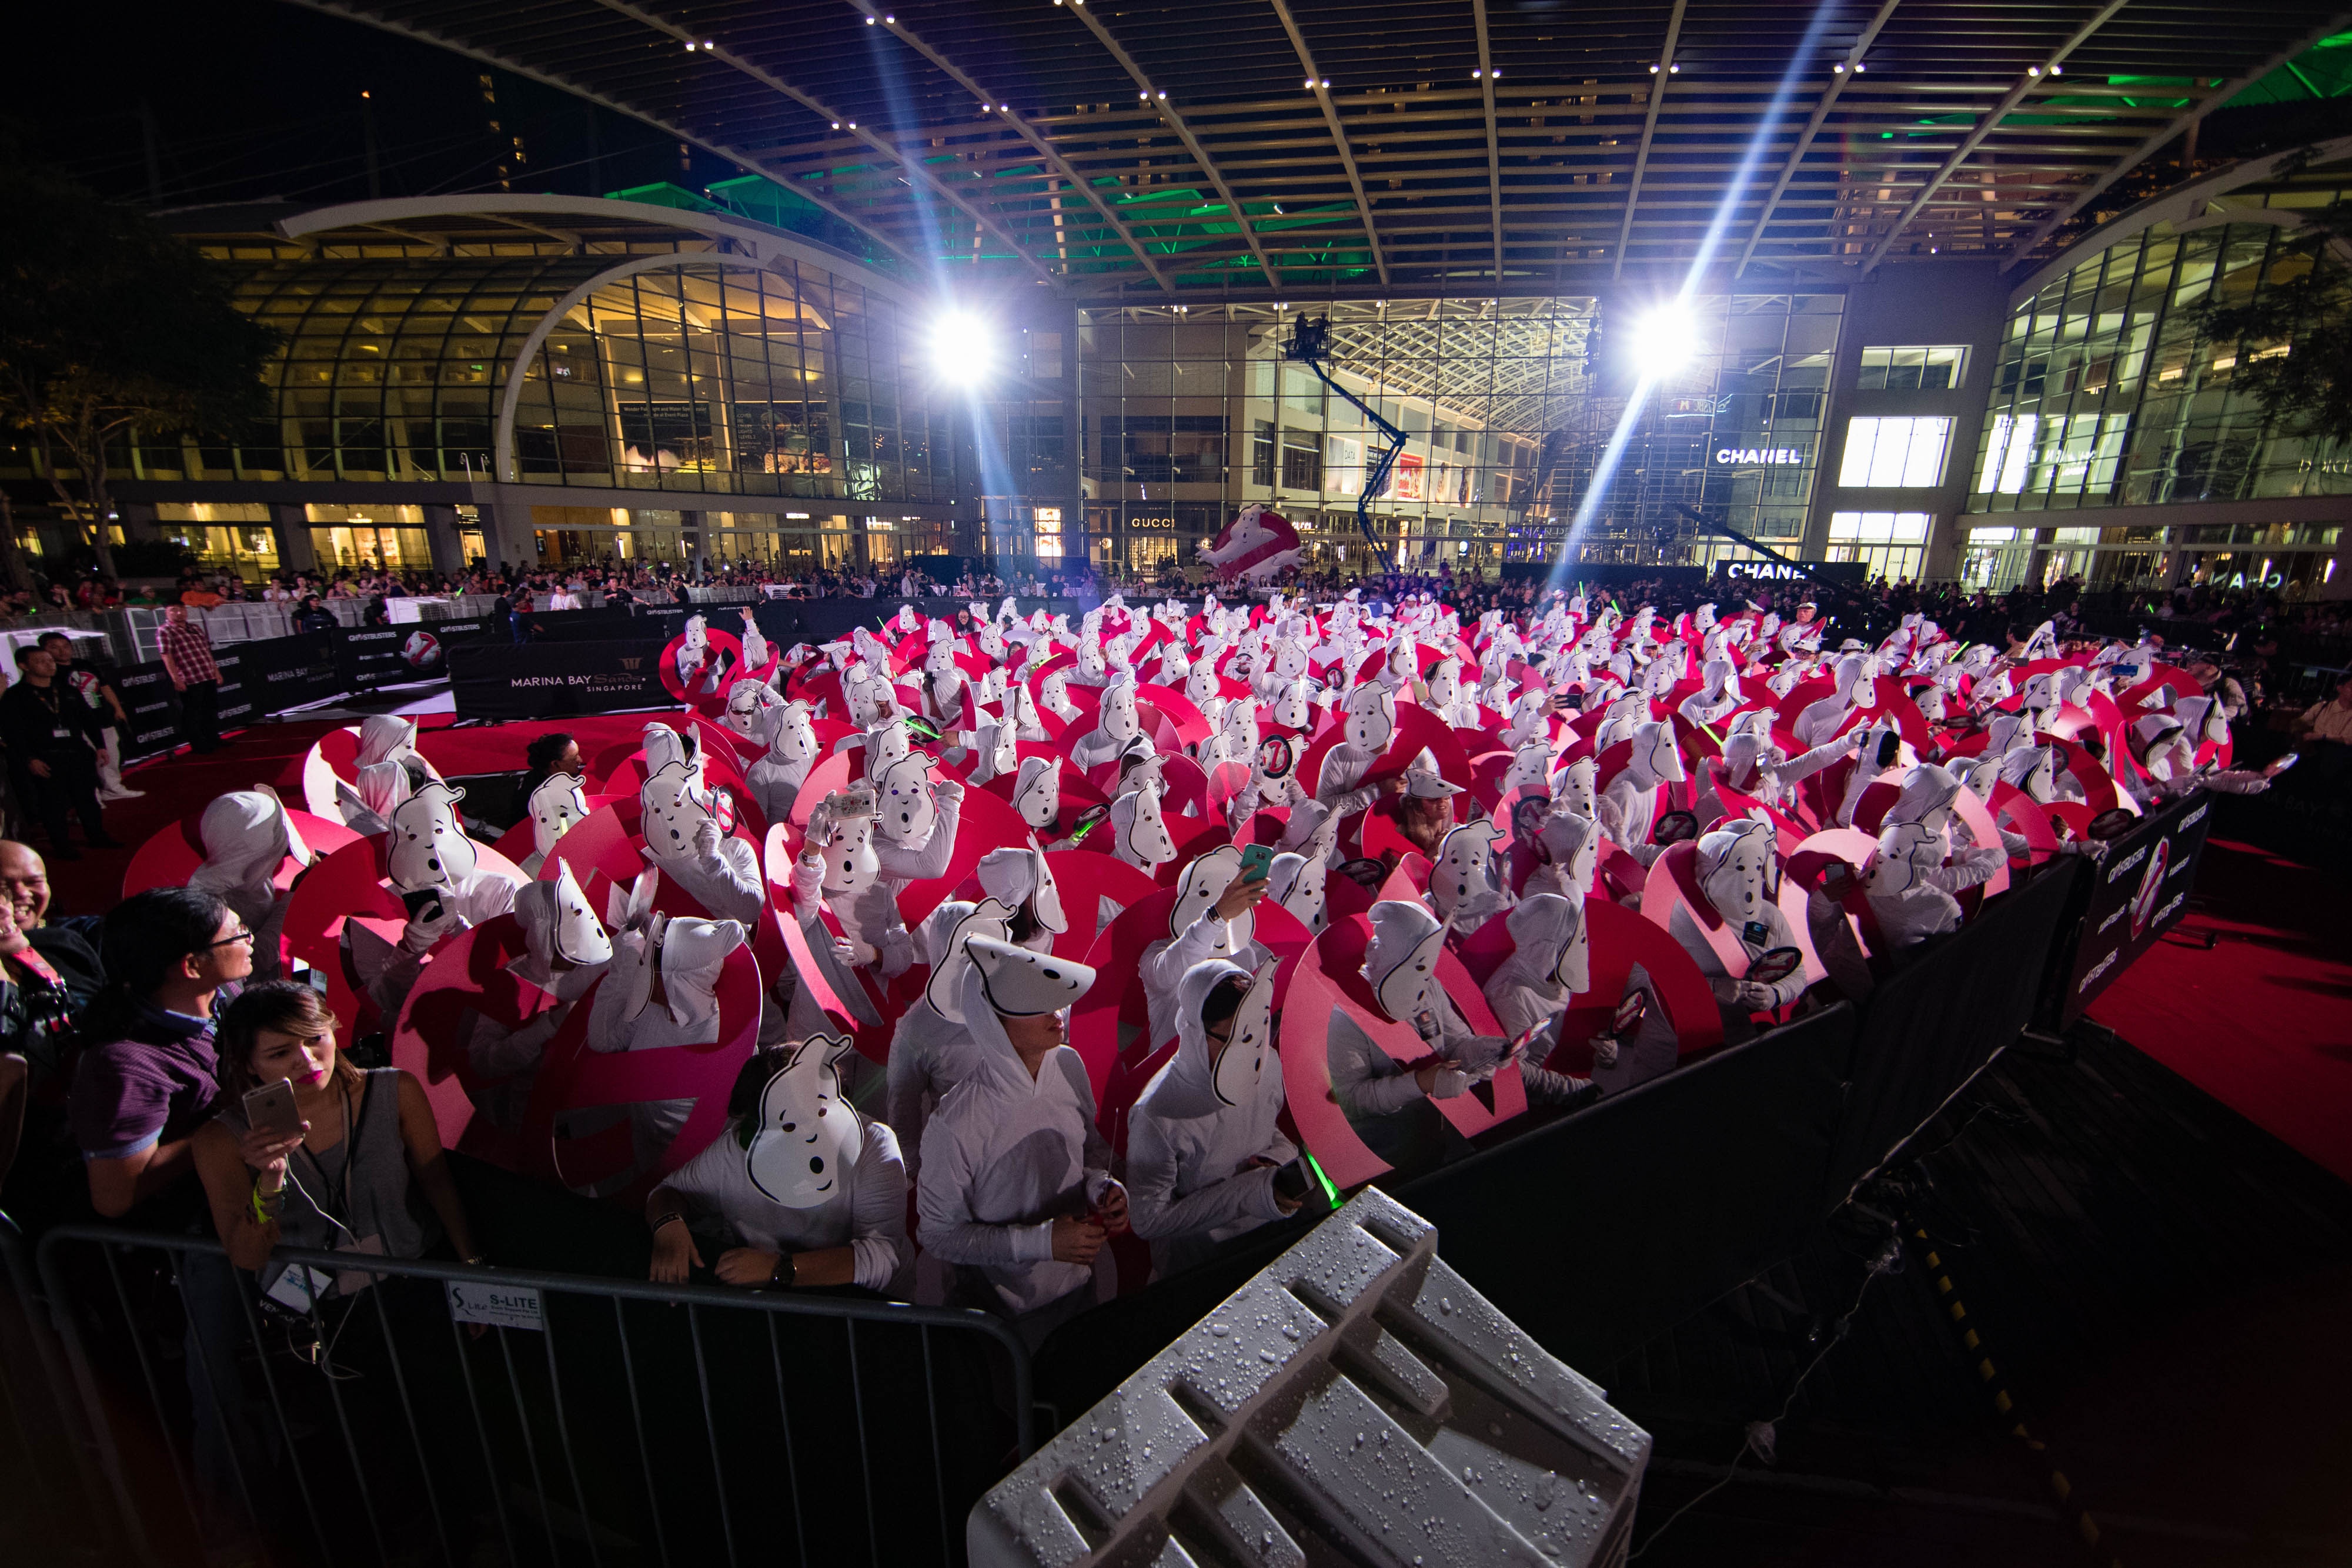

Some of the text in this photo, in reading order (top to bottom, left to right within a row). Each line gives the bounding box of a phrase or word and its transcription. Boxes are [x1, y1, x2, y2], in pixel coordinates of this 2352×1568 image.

[1345, 450, 1356, 460] DATA
[1716, 449, 1803, 464] CHANEL
[1131, 518, 1175, 528] GUCCI
[1412, 525, 1473, 535] MARNA
[510, 677, 564, 687] MARINA
[568, 675, 593, 685] BAY
[586, 684, 643, 692] SINGAPORE
[489, 1294, 539, 1309] S-LITE
